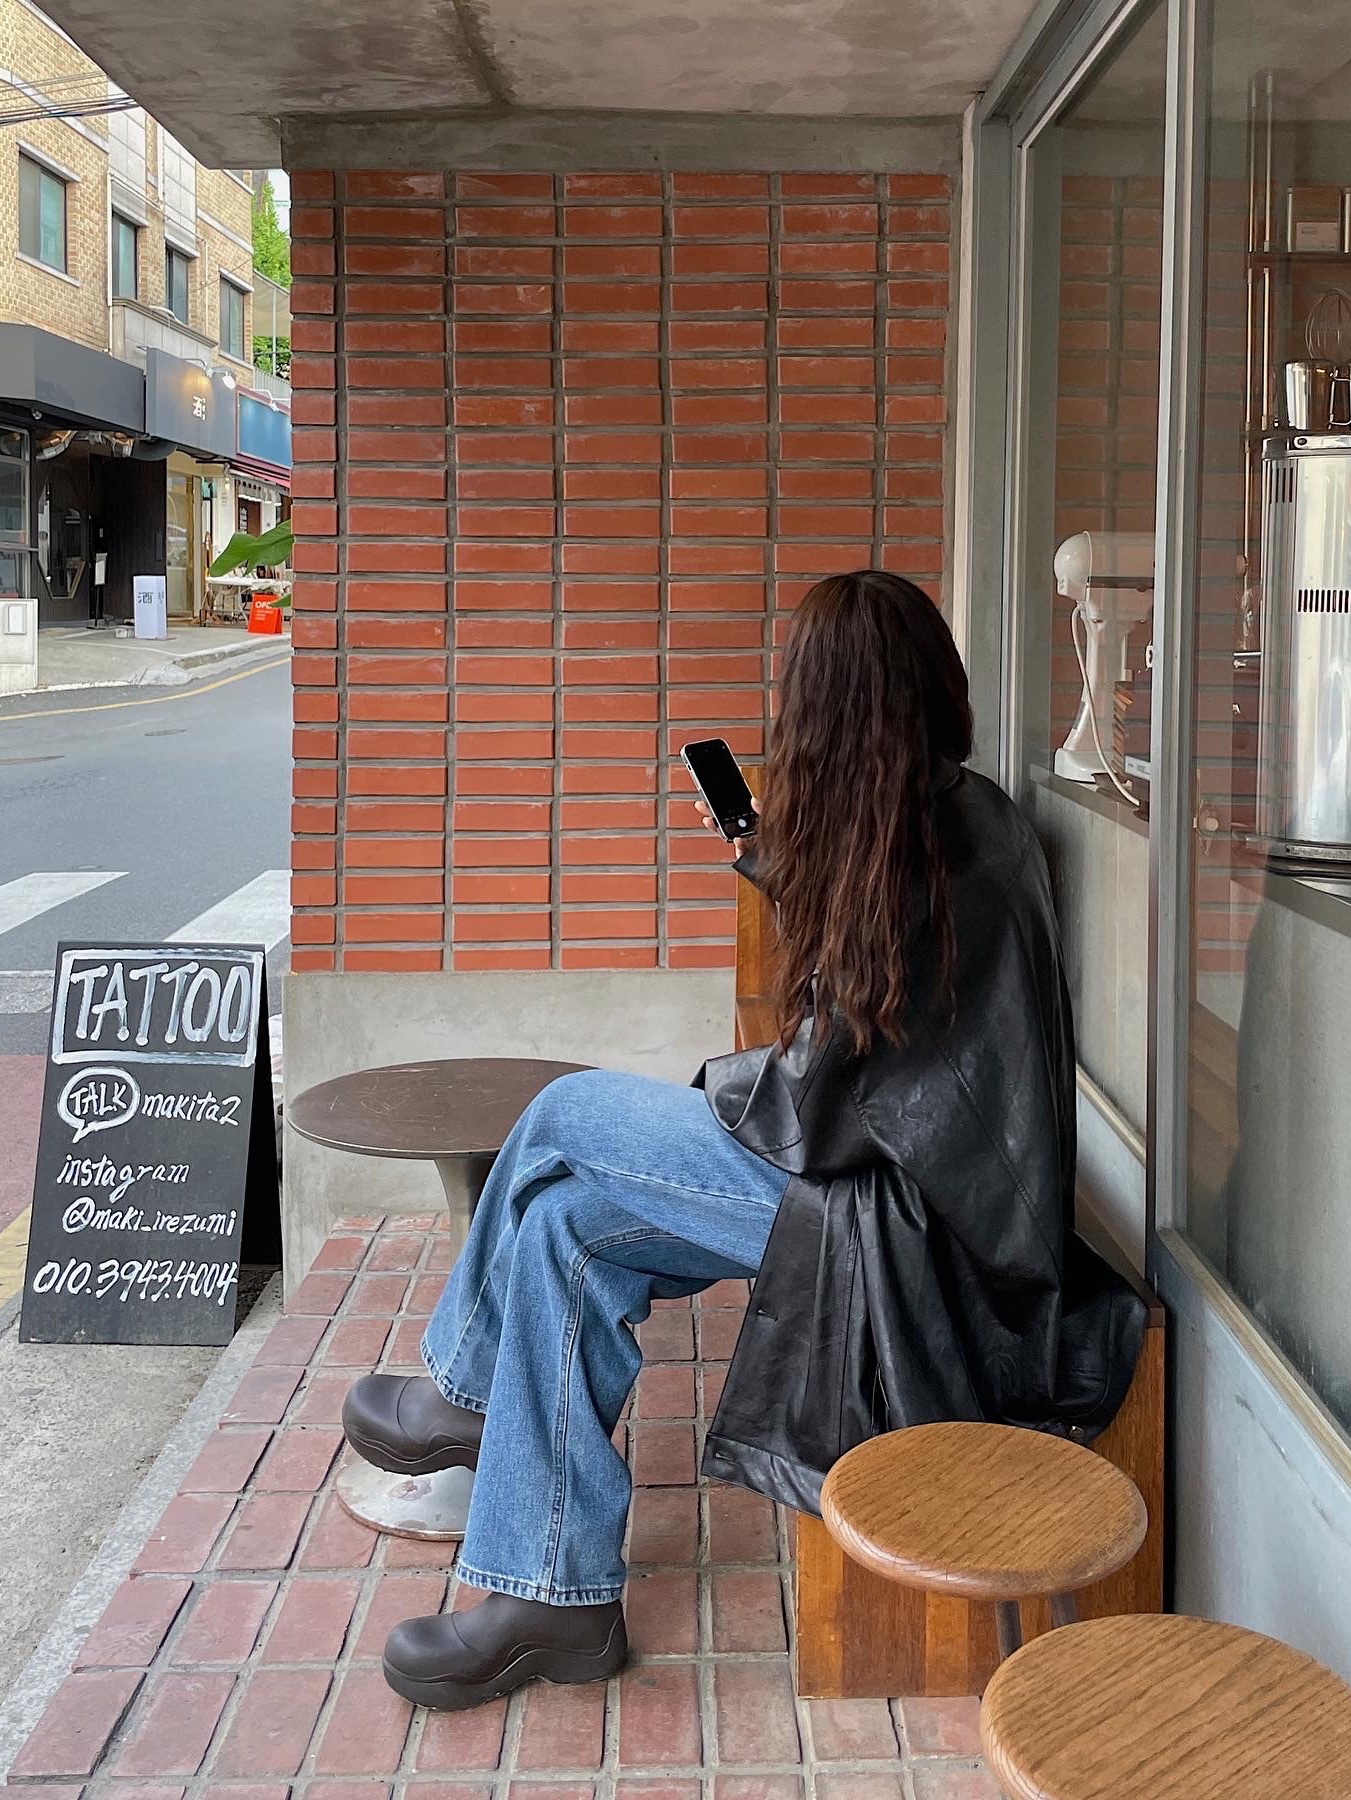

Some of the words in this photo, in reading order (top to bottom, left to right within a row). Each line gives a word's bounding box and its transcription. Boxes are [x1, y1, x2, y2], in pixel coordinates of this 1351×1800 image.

[70, 962, 251, 1045] TATTOO
[69, 1081, 128, 1115] TALK
[141, 1091, 241, 1126] makita2
[57, 1154, 190, 1203] instagram
[62, 1196, 237, 1236] @maki_irezumi
[33, 1257, 238, 1306] 010.3943.4004
